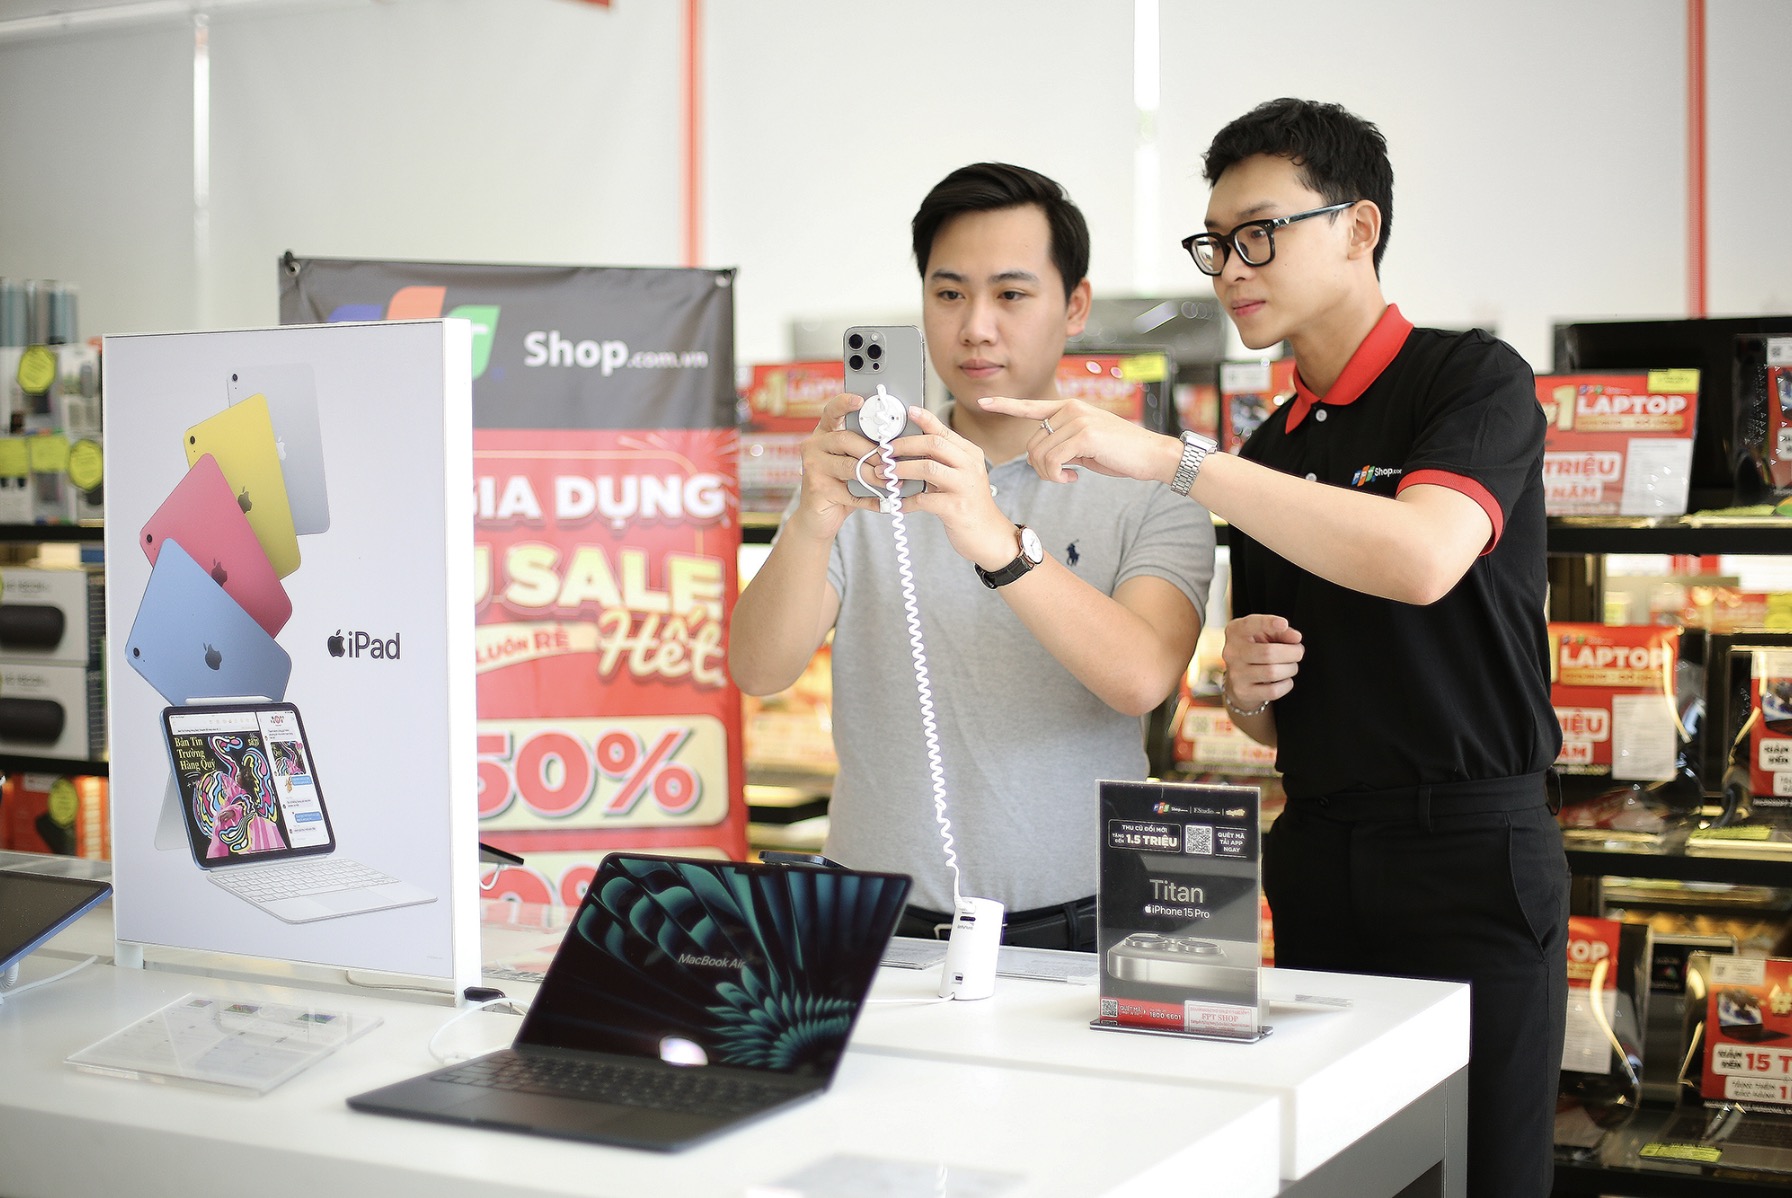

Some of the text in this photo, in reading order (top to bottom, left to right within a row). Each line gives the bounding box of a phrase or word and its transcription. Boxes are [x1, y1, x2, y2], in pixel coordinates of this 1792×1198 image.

[1577, 395, 1688, 415] LAPTOP
[473, 475, 727, 530] IA DỤNG
[505, 545, 724, 622] SALE
[348, 630, 401, 660] iPad
[598, 606, 728, 688] Hết
[477, 729, 703, 819] 50%
[1126, 834, 1178, 848] 1.5 TRIỆU
[1149, 879, 1204, 903] Titan
[1152, 904, 1211, 919] iPhone 15 Pro
[679, 953, 746, 968] MacBook Air
[1218, 1014, 1239, 1022] SHOP
[1746, 1052, 1771, 1072] 15
